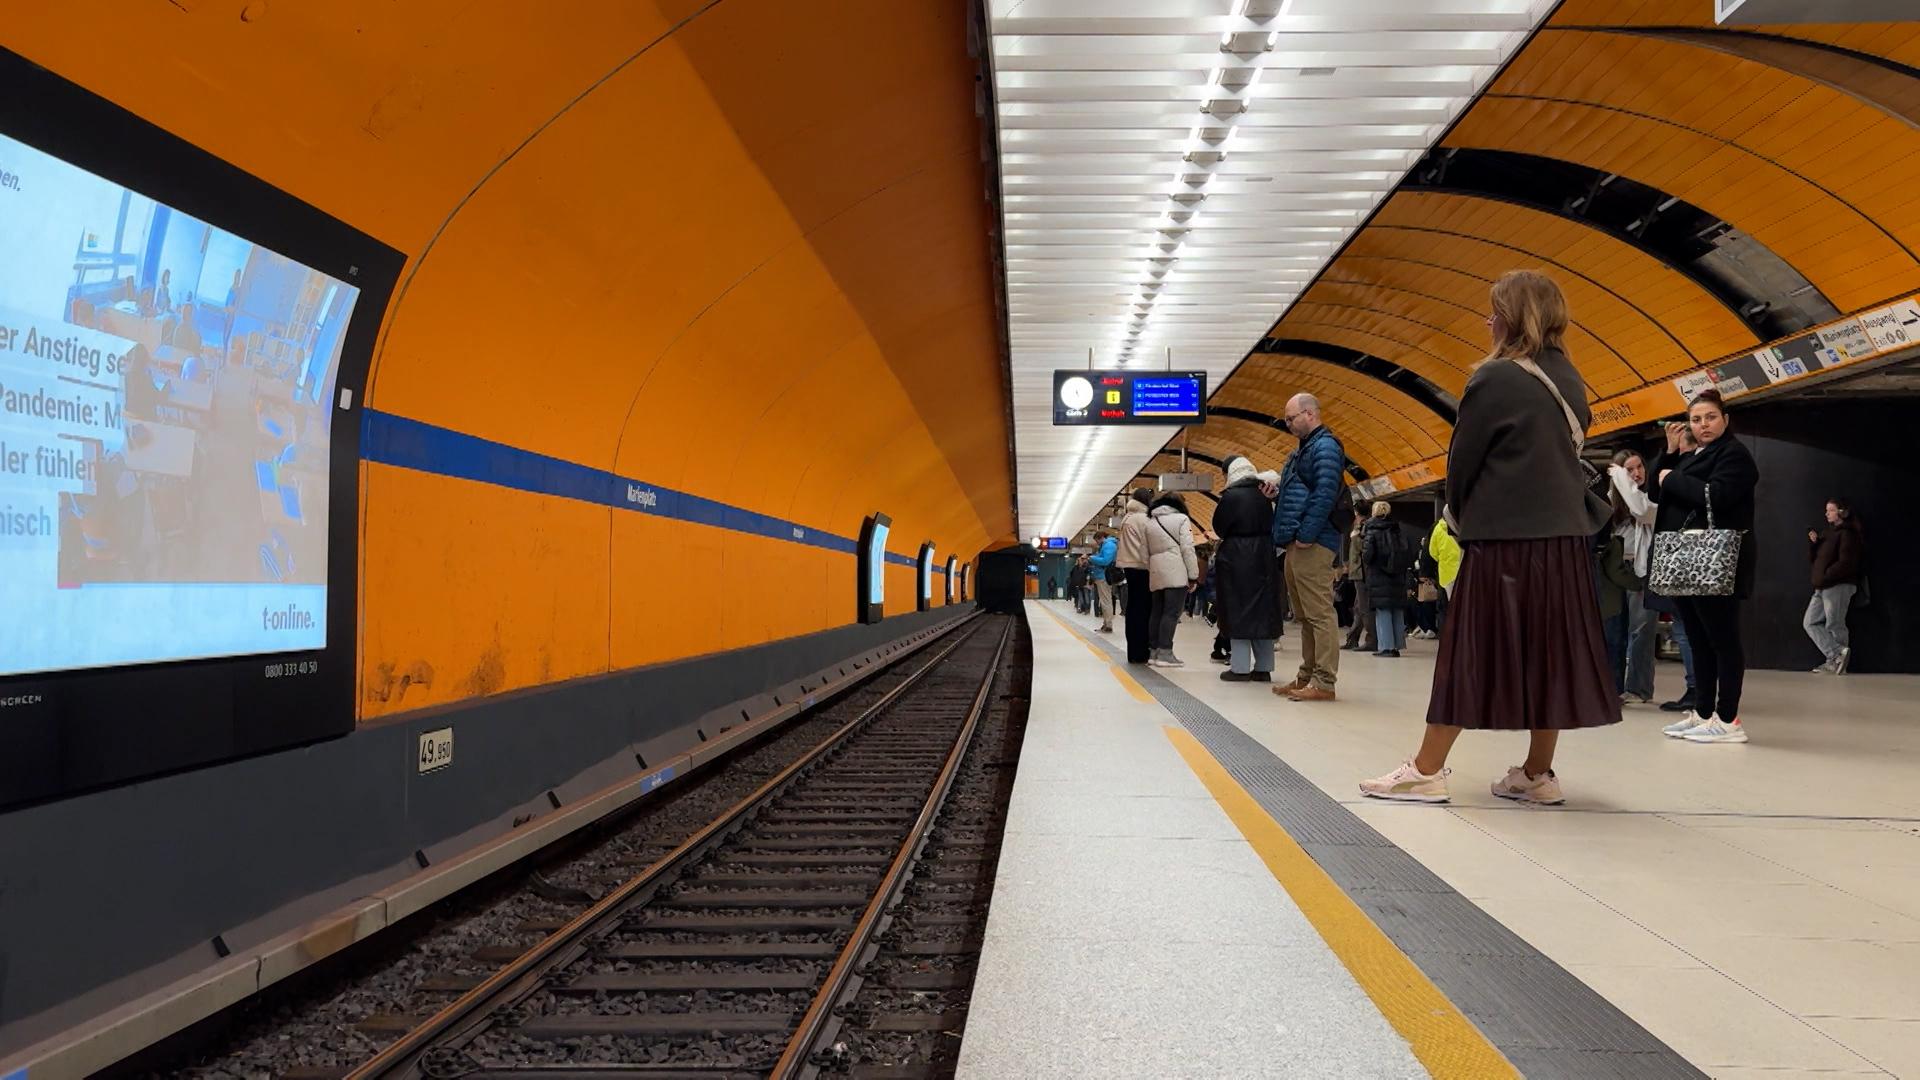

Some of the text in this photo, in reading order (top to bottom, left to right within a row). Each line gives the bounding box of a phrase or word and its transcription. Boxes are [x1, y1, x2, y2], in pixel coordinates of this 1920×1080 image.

[23, 326, 101, 377] Anstieg
[36, 445, 97, 481] fühlen
[628, 483, 656, 510] Marienplatz
[262, 603, 315, 630] t-online.
[265, 664, 283, 678] 0800
[284, 663, 298, 676] 333
